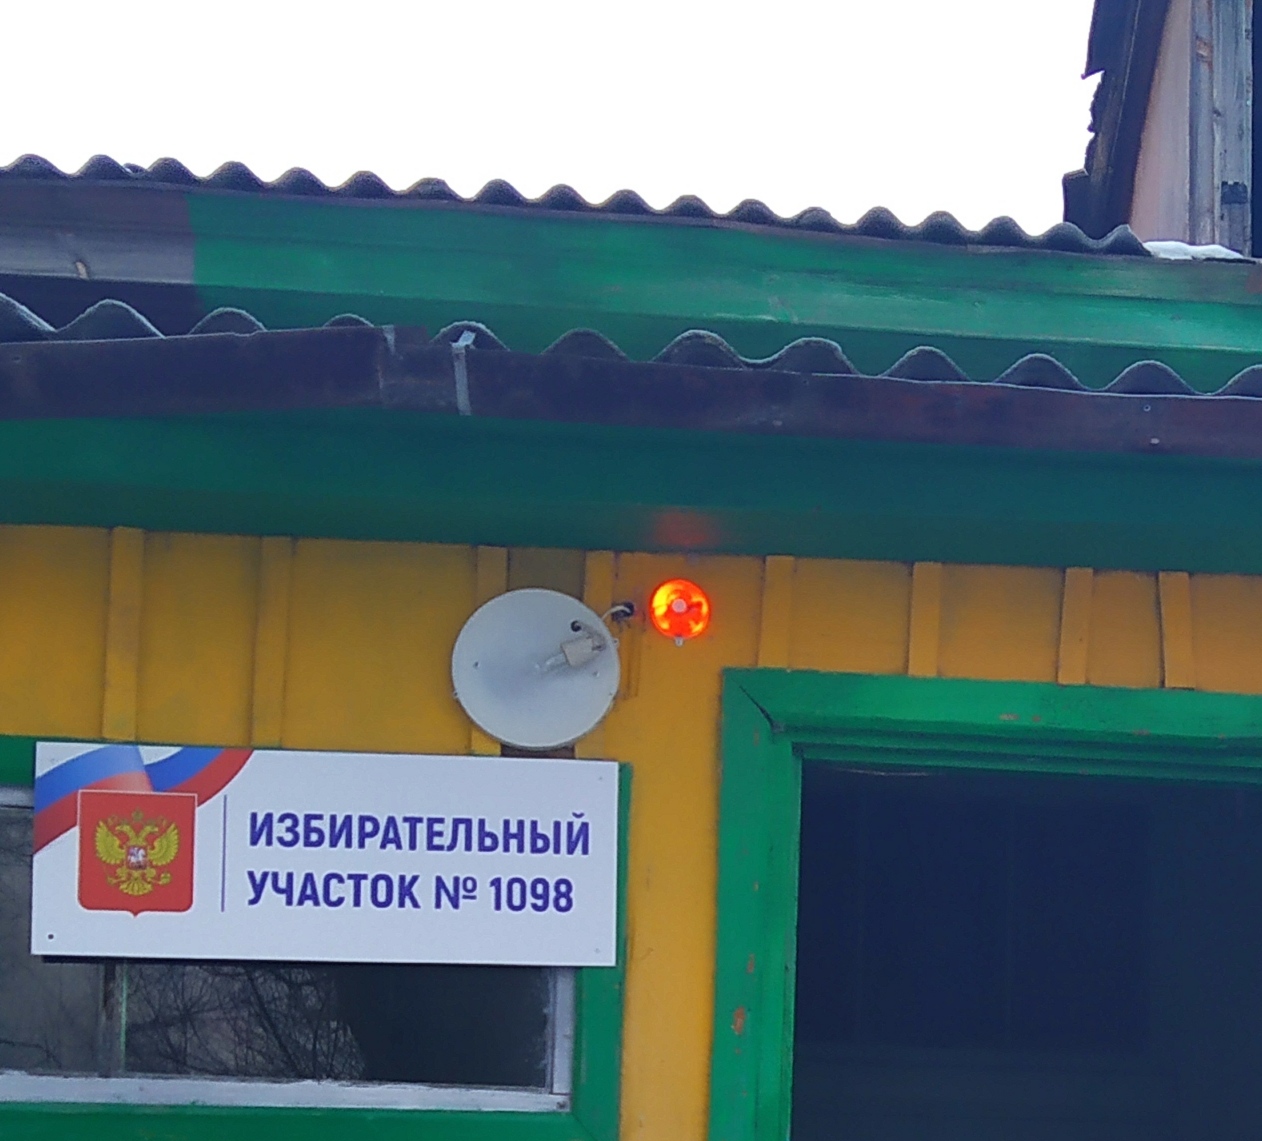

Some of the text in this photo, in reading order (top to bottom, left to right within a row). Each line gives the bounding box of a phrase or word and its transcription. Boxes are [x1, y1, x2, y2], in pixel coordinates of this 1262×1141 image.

[249, 811, 591, 856] ИЗБИРАТЕЛЬНЫЙ
[247, 869, 574, 913] УЧАСТОК № 1098
